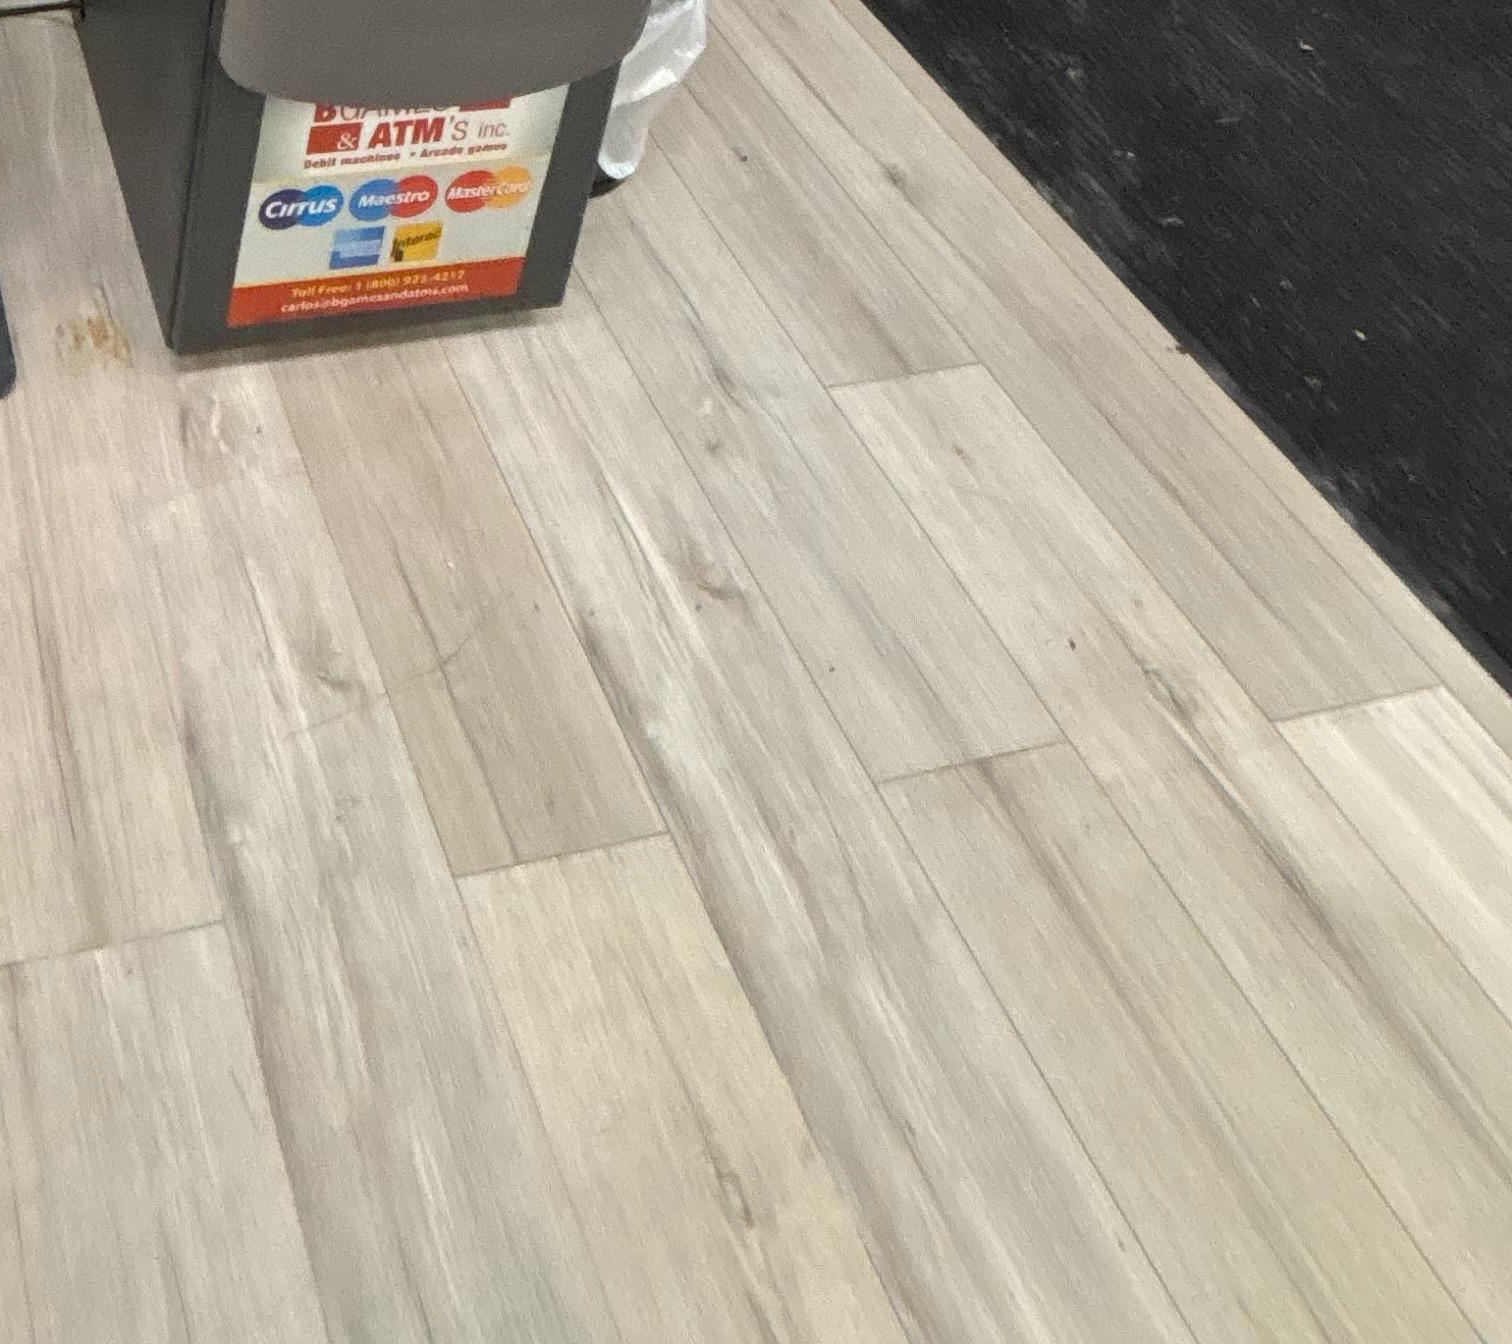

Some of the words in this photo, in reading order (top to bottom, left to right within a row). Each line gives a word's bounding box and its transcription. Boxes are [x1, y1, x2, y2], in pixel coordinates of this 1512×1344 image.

[304, 157, 336, 170] Debit
[340, 152, 401, 166] machines
[419, 145, 464, 158] Arcade
[467, 142, 508, 155] games
[265, 198, 338, 219] Cirrus
[358, 191, 430, 209] Maestro
[447, 182, 532, 202] MasterCard
[291, 287, 315, 298] Toll
